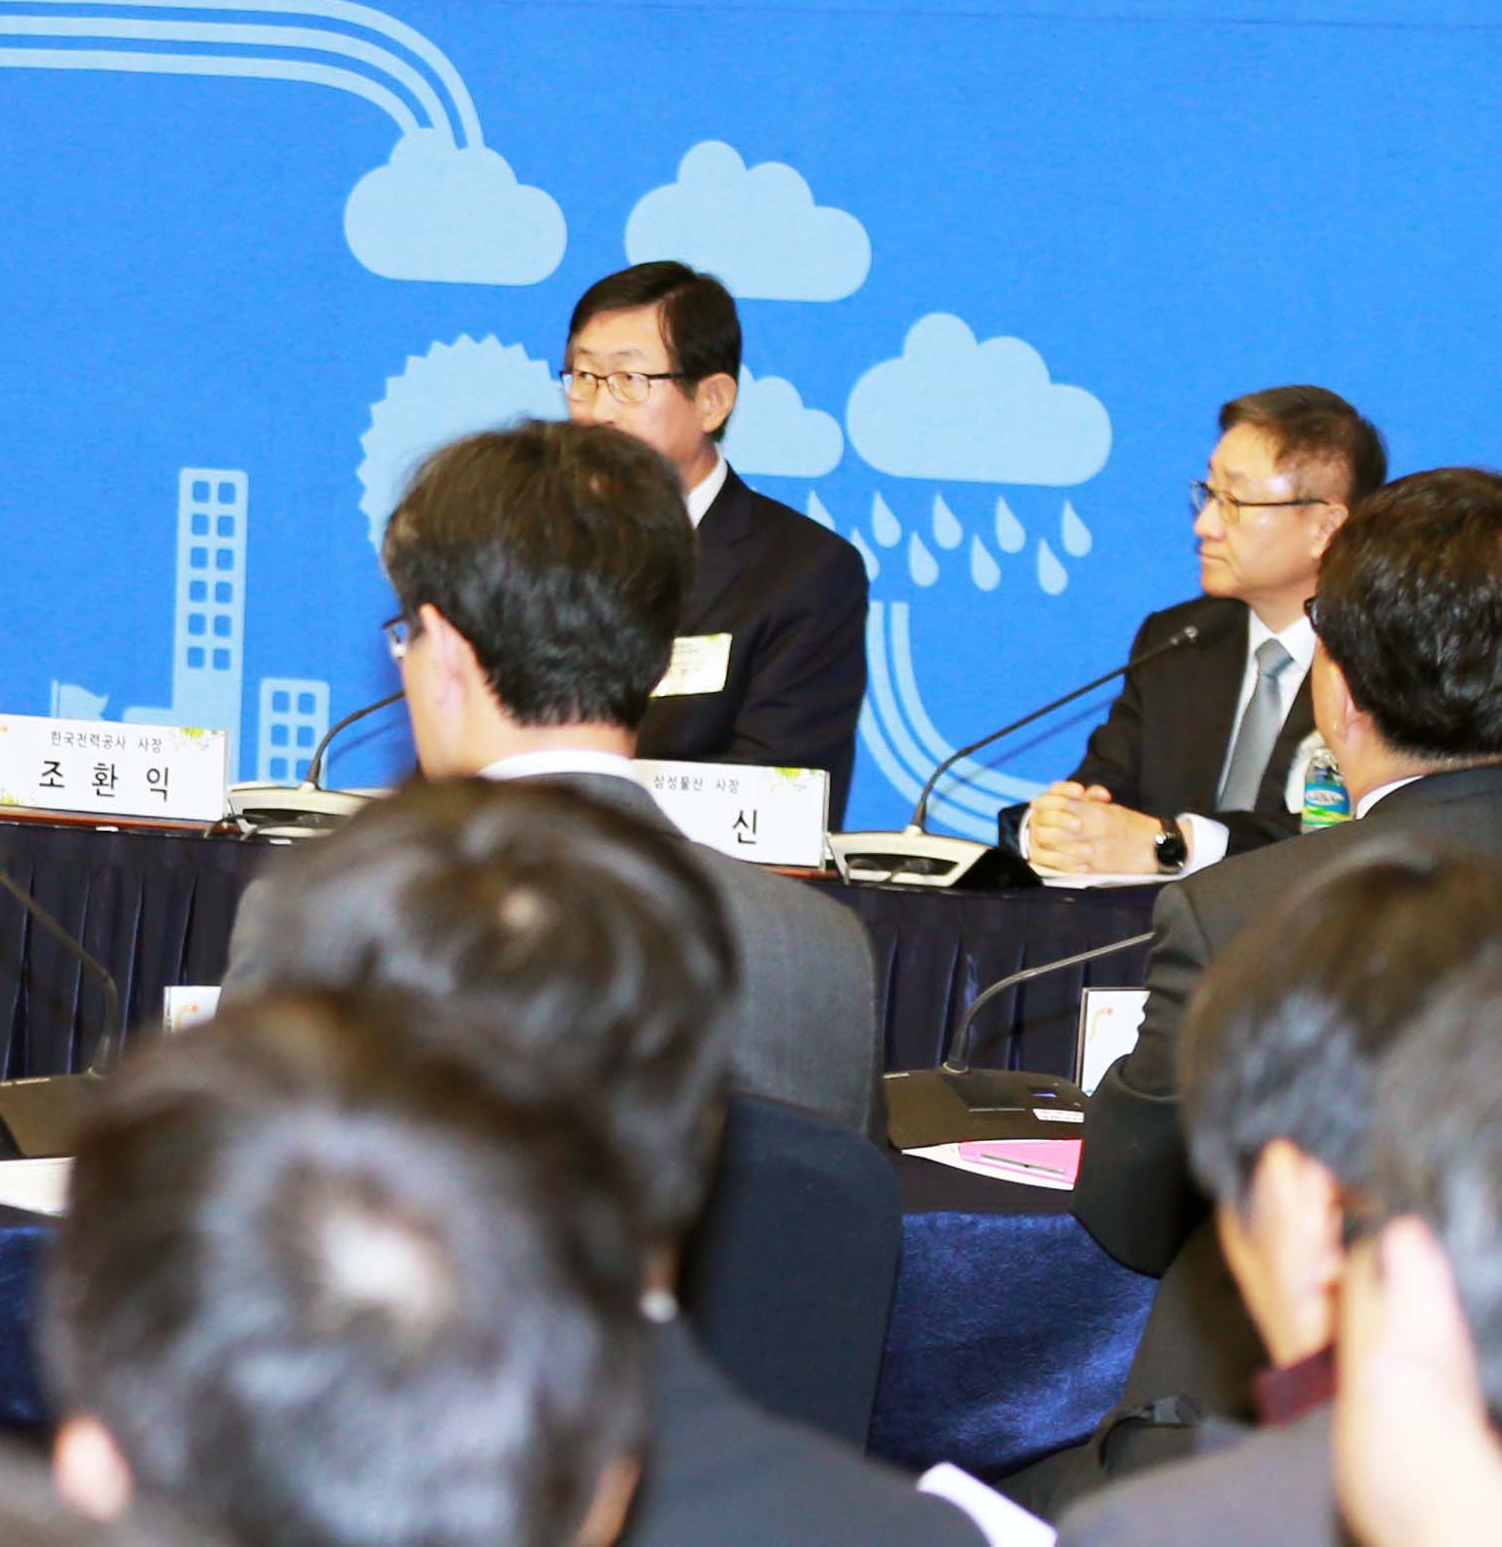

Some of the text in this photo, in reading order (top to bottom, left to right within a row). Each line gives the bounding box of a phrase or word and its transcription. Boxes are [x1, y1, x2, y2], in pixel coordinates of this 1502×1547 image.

[49, 728, 163, 754] 한국전력공사 사장
[39, 760, 169, 802] 조 환 익
[651, 774, 740, 795] 삼성물산 사장
[732, 809, 758, 845] 신
